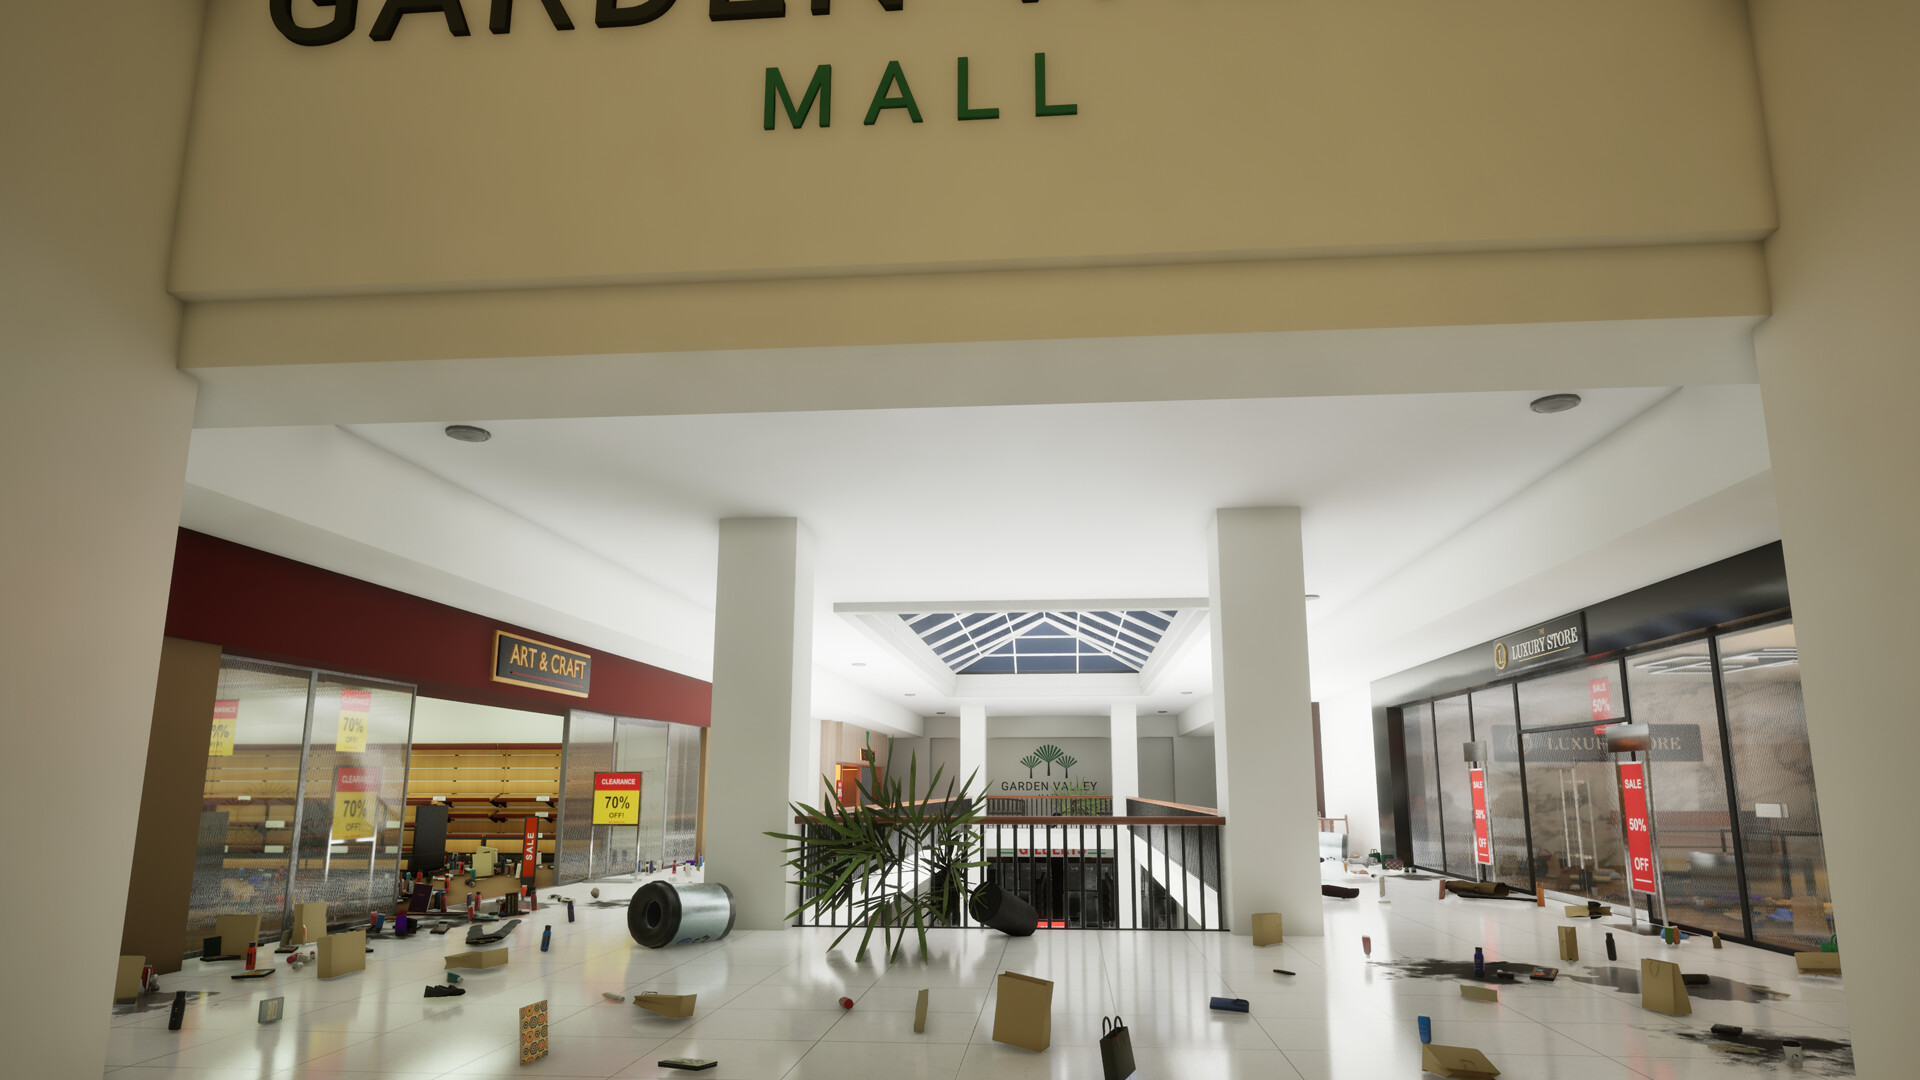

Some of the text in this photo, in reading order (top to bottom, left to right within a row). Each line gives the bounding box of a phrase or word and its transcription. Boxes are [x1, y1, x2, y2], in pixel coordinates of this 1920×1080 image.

[764, 52, 1078, 131] MALL
[1511, 627, 1578, 660] LUXURY STORE
[509, 643, 587, 680] ART & CRAFT
[1592, 682, 1607, 693] SALE
[1593, 698, 1611, 713] 50%
[343, 717, 364, 733] 70%
[1549, 737, 1608, 750] LUXUR
[1001, 781, 1049, 791] GARDEN
[1473, 780, 1483, 789] SALE
[1625, 778, 1642, 790] SALE
[343, 800, 368, 817] 70%
[605, 796, 630, 809] 70%
[1475, 809, 1486, 820] 50%
[1629, 817, 1647, 832] 50%
[525, 832, 535, 861] SALE
[1478, 837, 1487, 849] OFF
[1634, 857, 1650, 872] OFF
